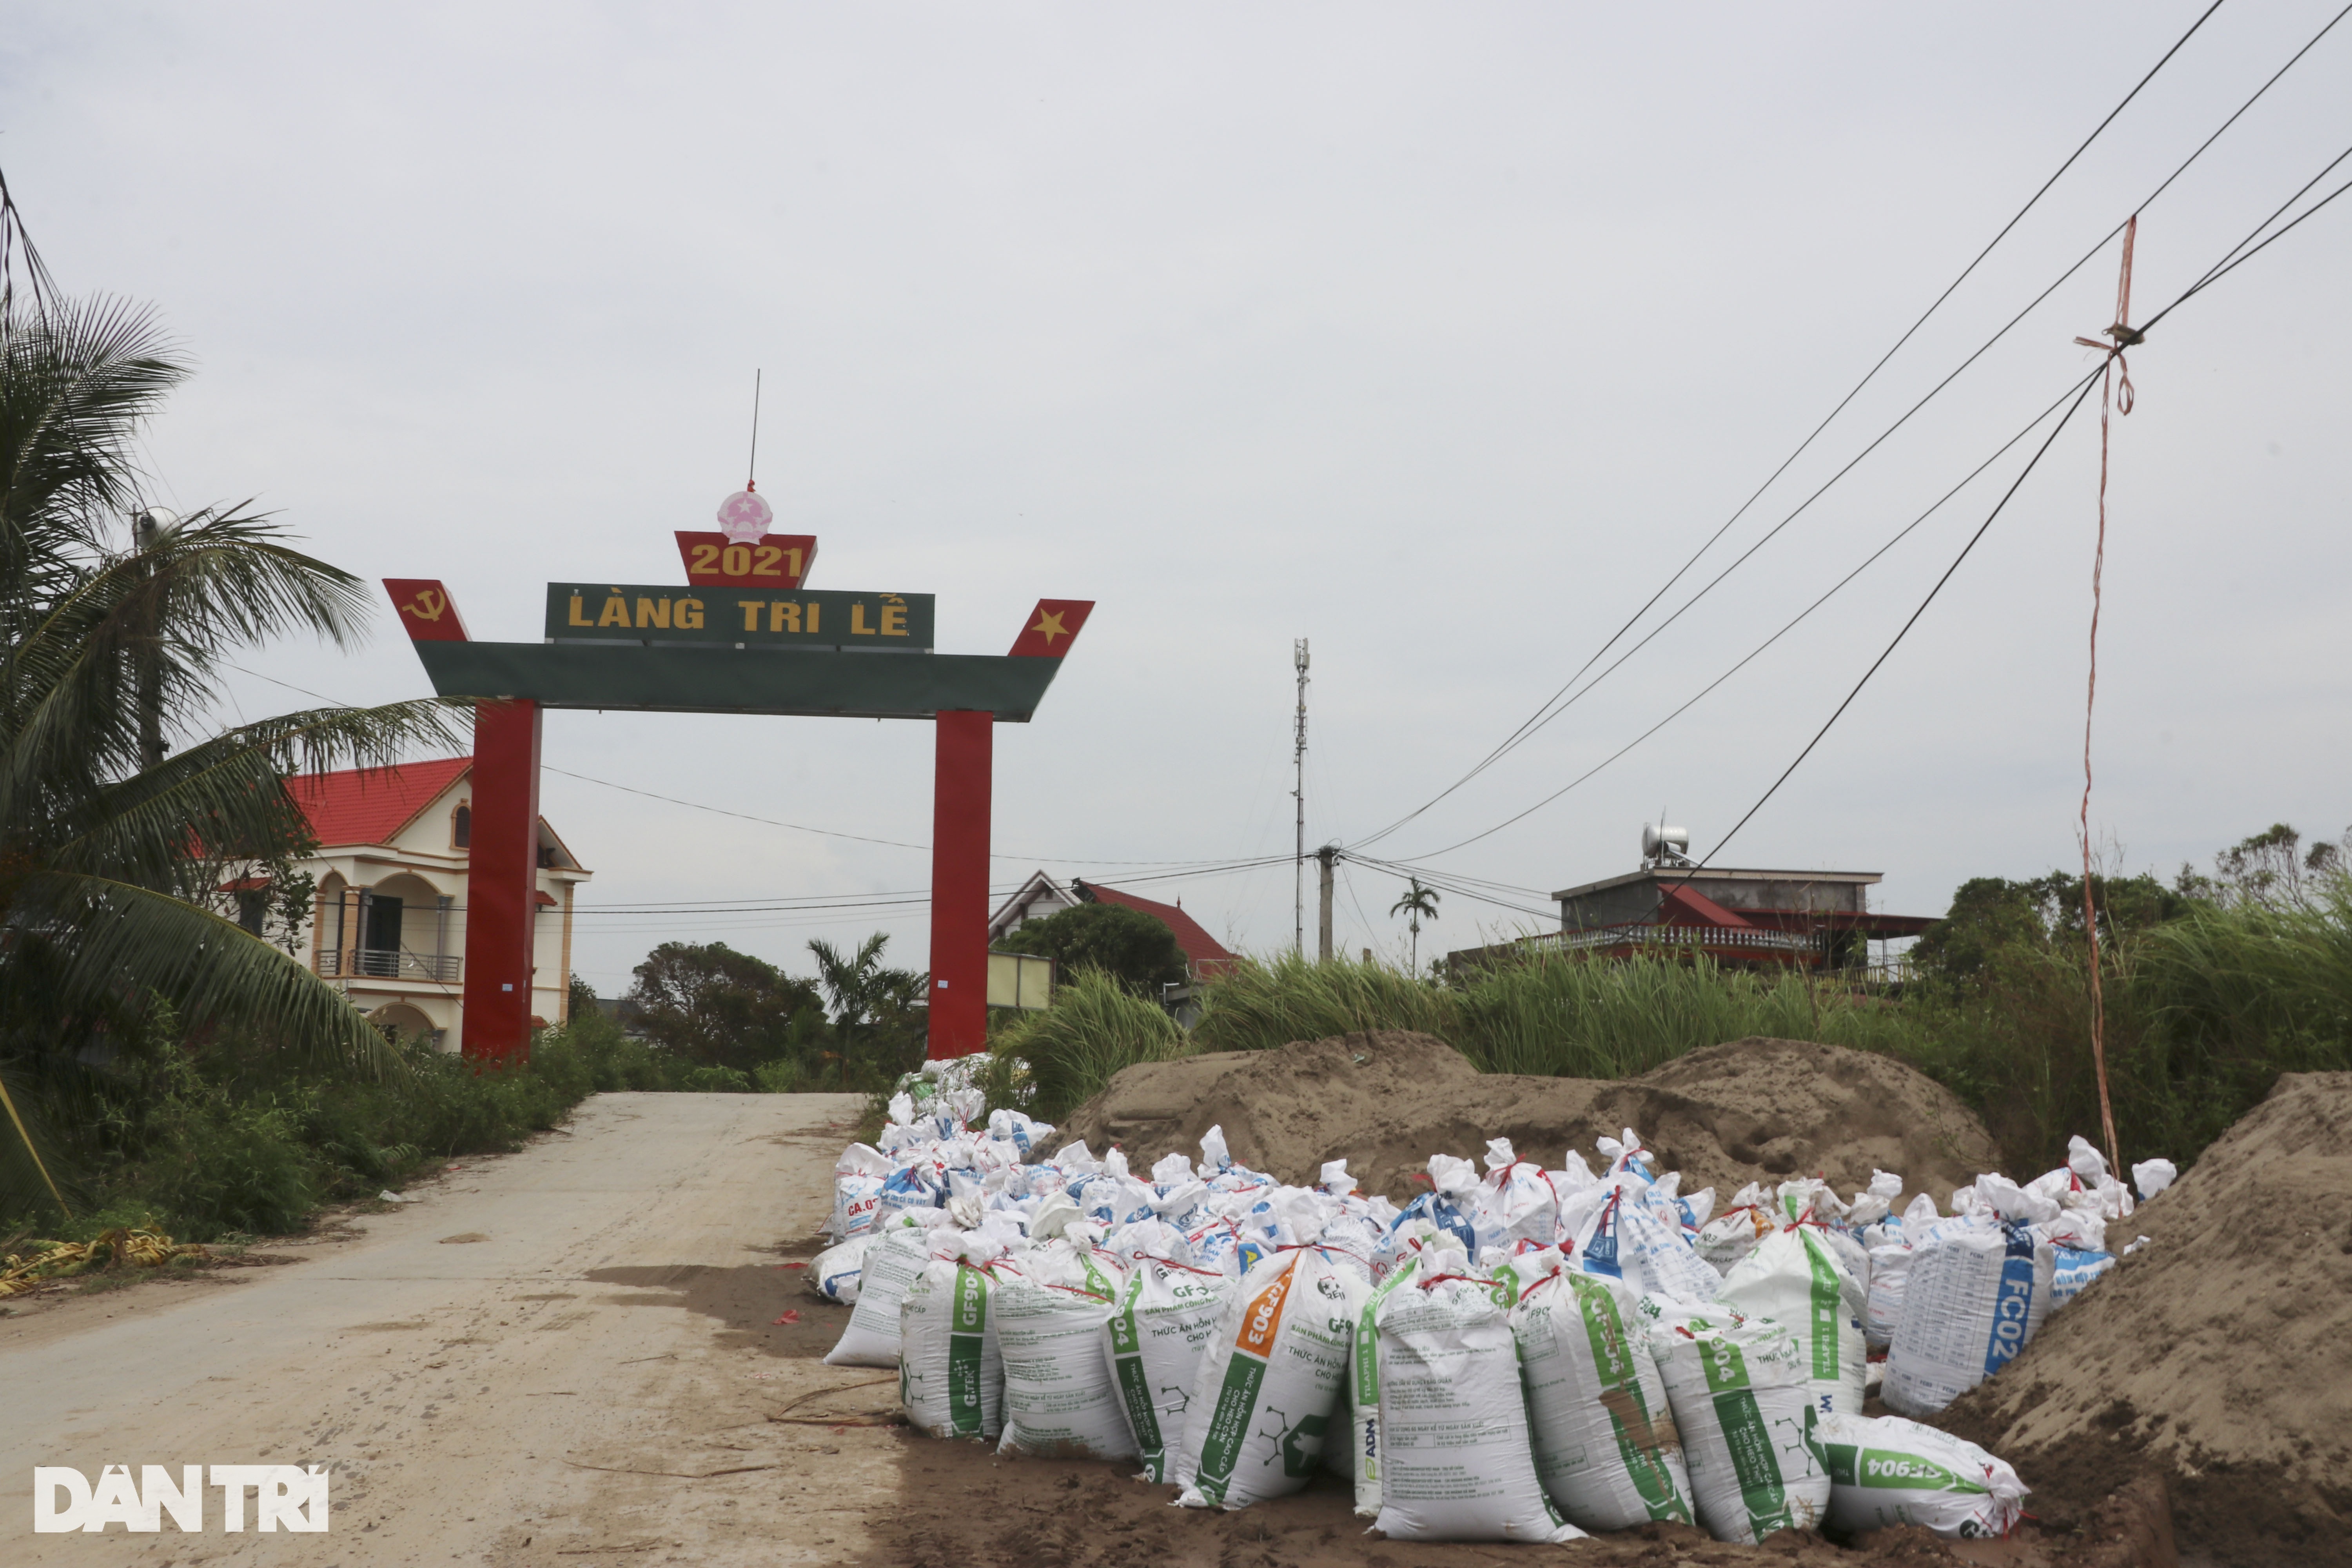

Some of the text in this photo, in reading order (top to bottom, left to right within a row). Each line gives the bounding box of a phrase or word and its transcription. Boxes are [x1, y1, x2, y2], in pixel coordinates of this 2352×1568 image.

[690, 544, 802, 577] 2021
[569, 587, 909, 636] LÀNG TRI LỄ
[1992, 1279, 2029, 1359] FC02
[1152, 1325, 1176, 1338] THỨC
[1186, 1332, 1205, 1343] CHO
[1289, 1346, 1312, 1361] THỨC
[1314, 1355, 1326, 1367] ĂN
[1245, 1367, 1256, 1388] THỨC
[1315, 1368, 1331, 1379] CHO
[1362, 1357, 1371, 1399] TILAPHI
[1241, 1388, 1251, 1402] ĂN
[1219, 1389, 1240, 1443] CHO HEO CON
[1223, 1437, 1234, 1455] CAO
[1366, 1418, 1376, 1457] ADM
